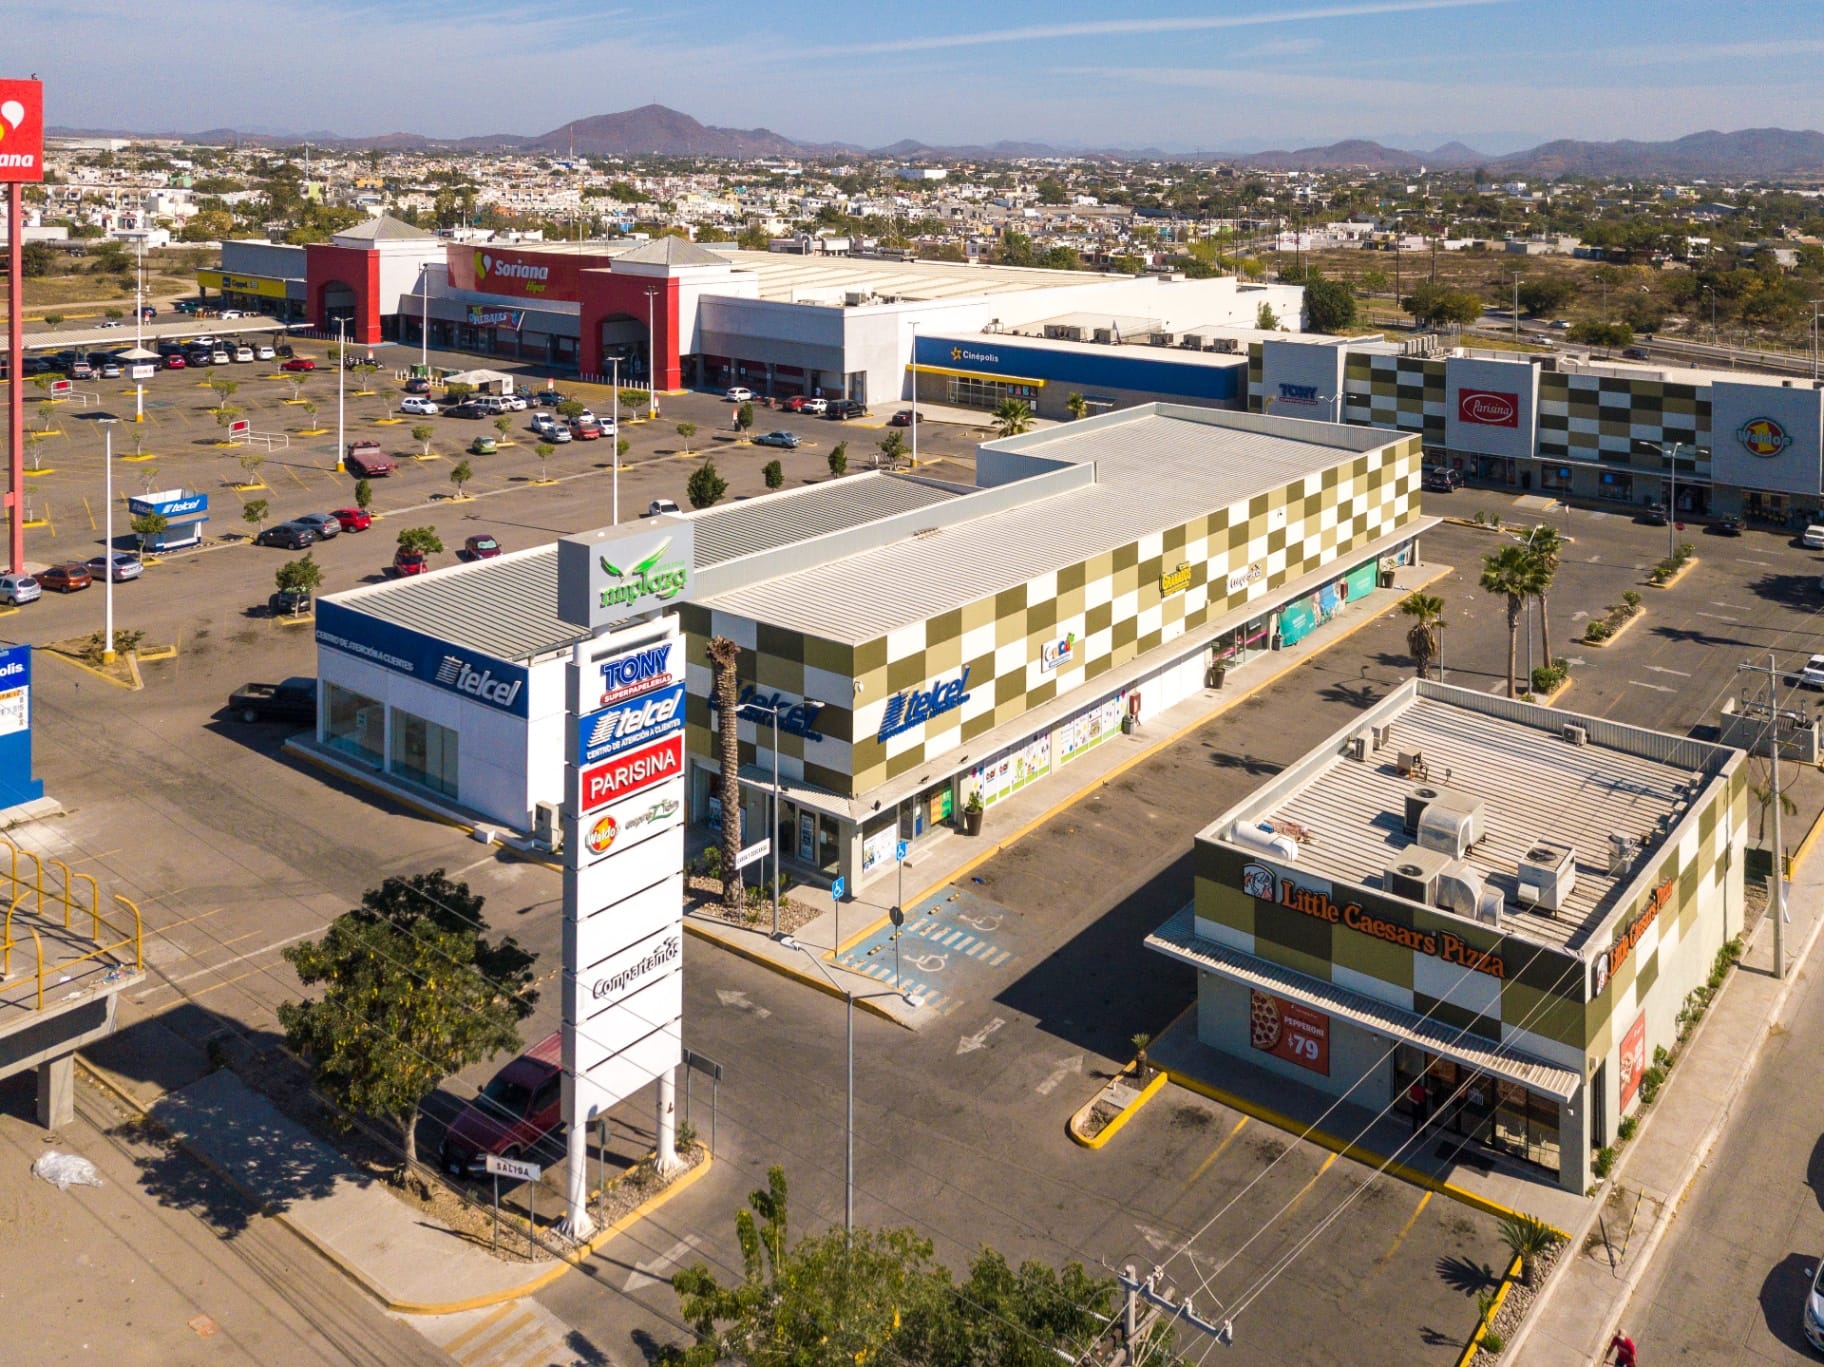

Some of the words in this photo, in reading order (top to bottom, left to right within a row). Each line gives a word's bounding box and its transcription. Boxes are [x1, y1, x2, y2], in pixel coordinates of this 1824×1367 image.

[495, 259, 549, 280] Soriana
[962, 350, 999, 363] Cinépolis
[1278, 384, 1318, 400] TONY
[457, 663, 522, 706] telcel
[601, 643, 672, 692] TONY
[615, 688, 683, 738] telcel
[904, 664, 970, 724] telcel
[587, 745, 612, 760] CENTRO
[612, 740, 621, 751] DE
[654, 718, 681, 733] CLIENTES
[590, 748, 676, 800] PARISINA
[1280, 878, 1340, 925] Little
[1343, 902, 1437, 956] Caesars
[1440, 929, 1506, 979] Pizza
[592, 937, 680, 999] Compartamos
[1287, 1031, 1319, 1060] $79
[496, 1162, 530, 1177] SALIDA
